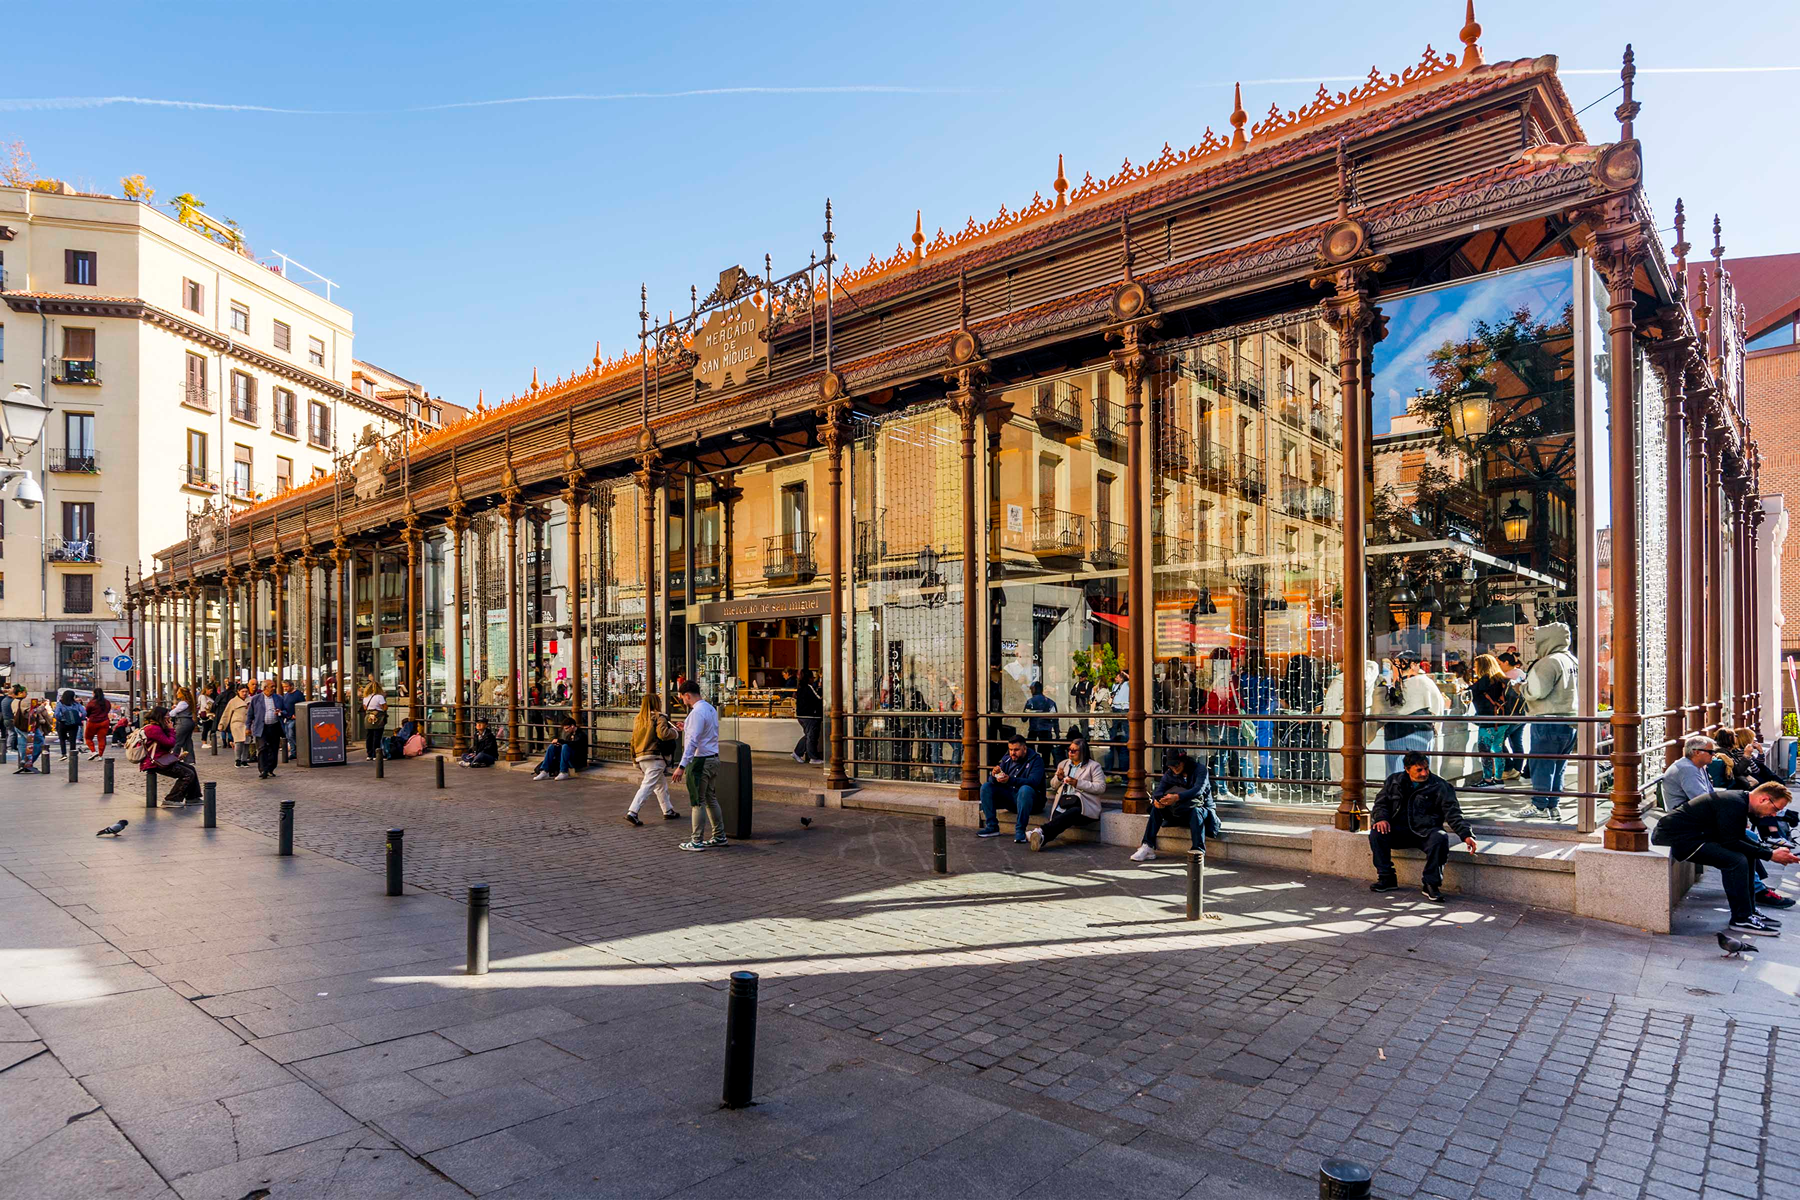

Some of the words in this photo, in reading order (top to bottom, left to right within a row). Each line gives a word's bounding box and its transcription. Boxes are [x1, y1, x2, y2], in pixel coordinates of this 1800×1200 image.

[706, 318, 756, 347] MERCADO
[724, 342, 735, 352] DE
[701, 357, 719, 375] SAN
[723, 345, 756, 368] MIGUEL
[723, 601, 757, 616] mercado
[760, 600, 769, 613] de
[772, 602, 787, 612] san
[789, 596, 819, 613] miguel
